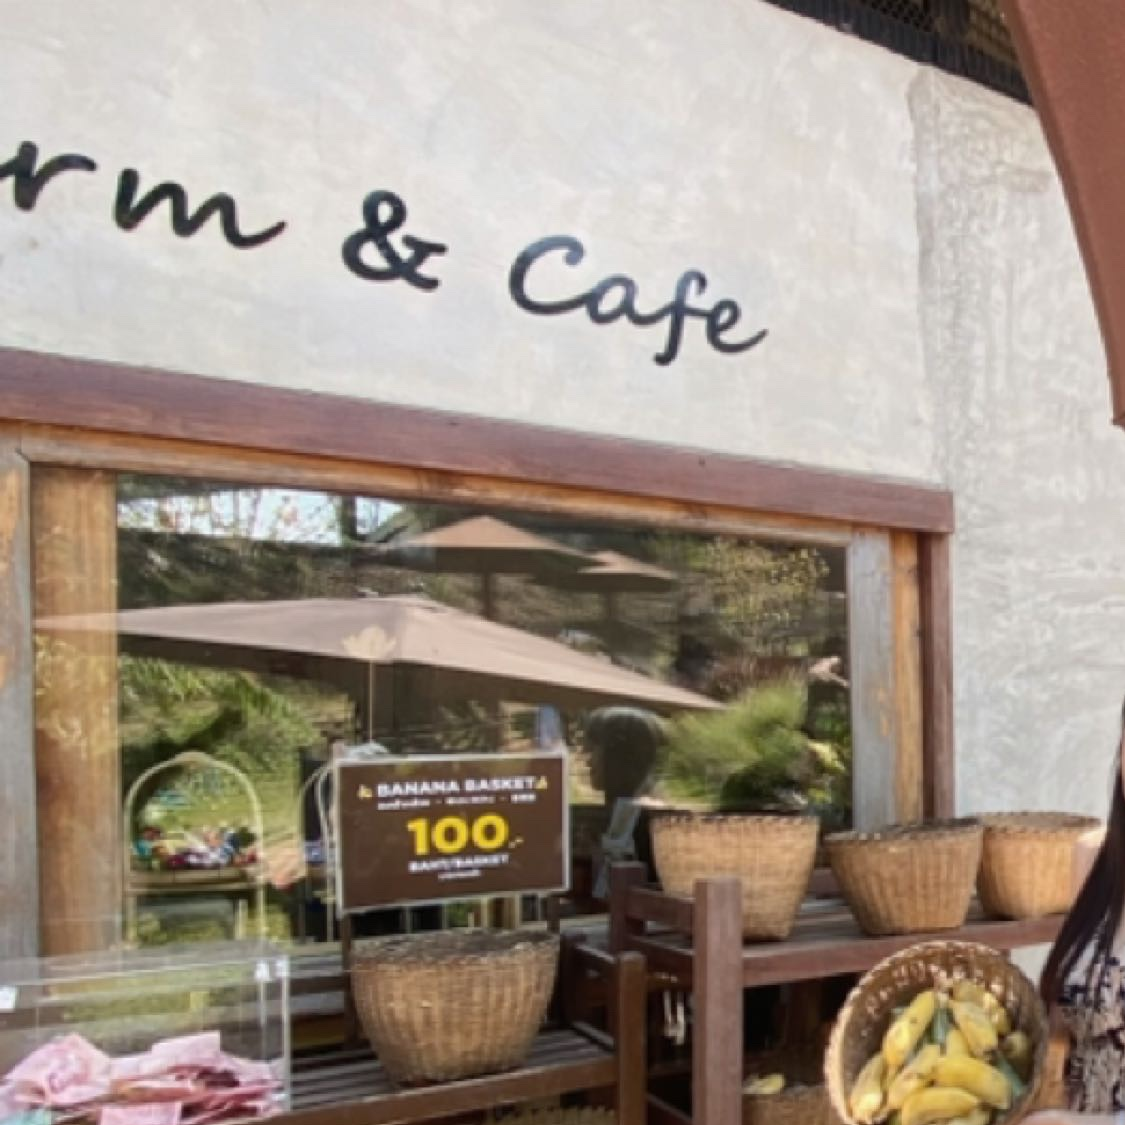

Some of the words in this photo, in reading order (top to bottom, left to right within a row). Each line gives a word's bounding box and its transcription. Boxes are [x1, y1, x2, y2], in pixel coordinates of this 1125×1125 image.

[341, 189, 448, 290] &
[508, 235, 768, 365] Cafe
[376, 778, 461, 798] BANANA
[464, 775, 536, 793] BASKET
